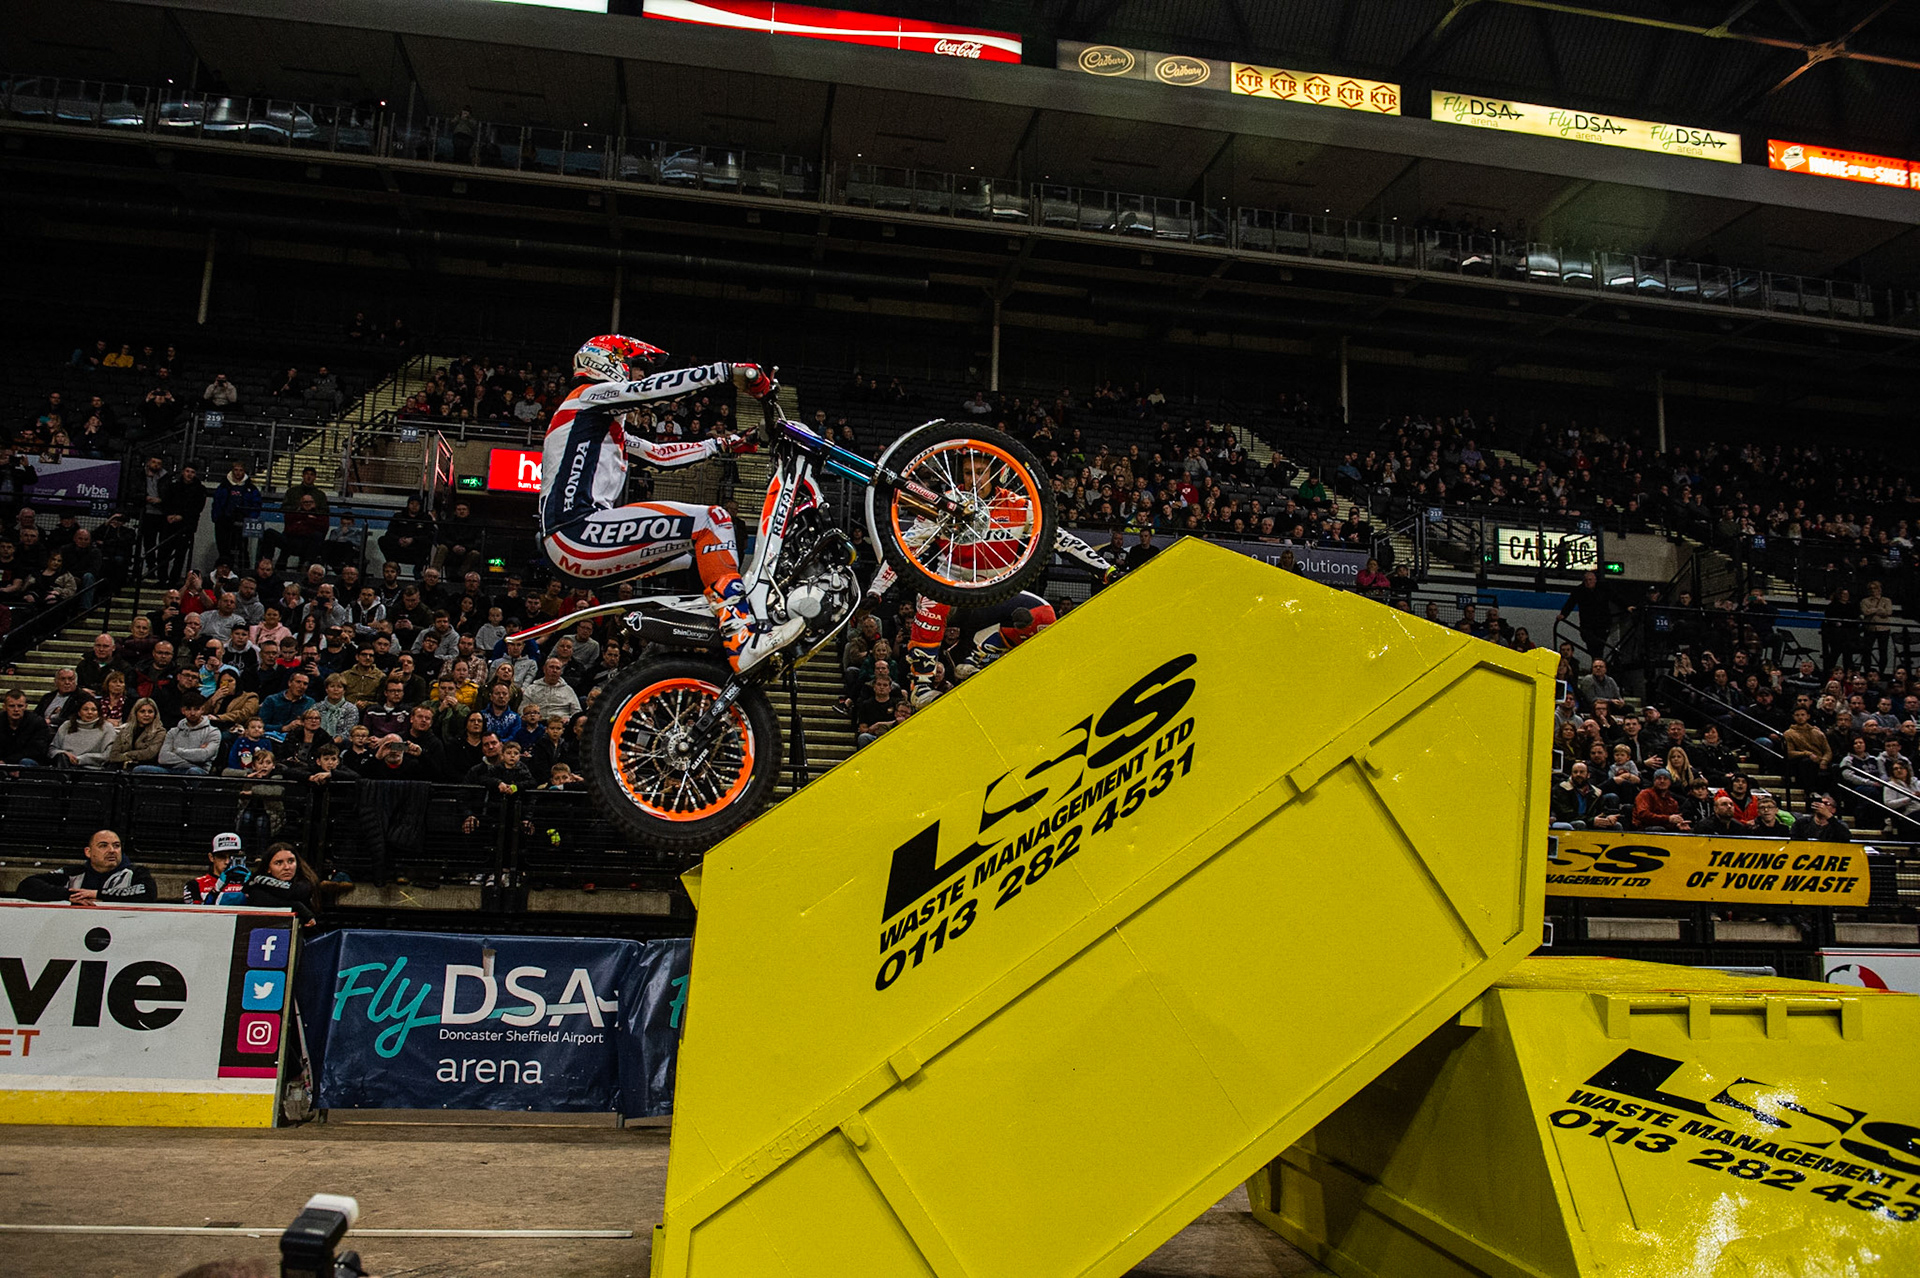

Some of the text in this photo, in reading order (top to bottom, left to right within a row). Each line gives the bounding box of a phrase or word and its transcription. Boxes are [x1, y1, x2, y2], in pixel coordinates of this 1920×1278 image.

[1084, 51, 1127, 68] Cadbury
[1161, 61, 1203, 78] Cadbury
[1236, 73, 1397, 105] KTR KTR KTR KTR KTR
[1471, 117, 1499, 128] arena
[1576, 131, 1602, 141] arena
[1677, 144, 1703, 156] arena
[583, 357, 624, 382] hebo
[626, 366, 719, 393] REPSOL
[586, 389, 620, 401] hebo
[205, 414, 222, 423] 219
[402, 429, 417, 437] 218
[563, 440, 590, 513] HONDA
[906, 481, 939, 502] SHOWA
[92, 502, 108, 511] 119
[245, 522, 262, 531] 118
[580, 517, 682, 543] REPSOL
[641, 540, 691, 558] hebo
[1296, 558, 1359, 576] olutions
[1656, 618, 1669, 627] 116
[881, 653, 1197, 925] LSS
[880, 716, 1196, 955] WASTE MANAGEMENT LTD
[874, 742, 1196, 992] 0113 282 4531
[1707, 850, 1852, 872] TAKING CARE
[1621, 876, 1652, 887] LTD
[1686, 871, 1860, 893] OF YOUR WASTE
[439, 1028, 604, 1046] Doncaster Sheffield Airport
[436, 1057, 543, 1084] arena
[1566, 1089, 1907, 1191] WASTE MANAGEMENT
[1549, 1109, 1679, 1154] 0113
[1687, 1149, 1808, 1192] 282
